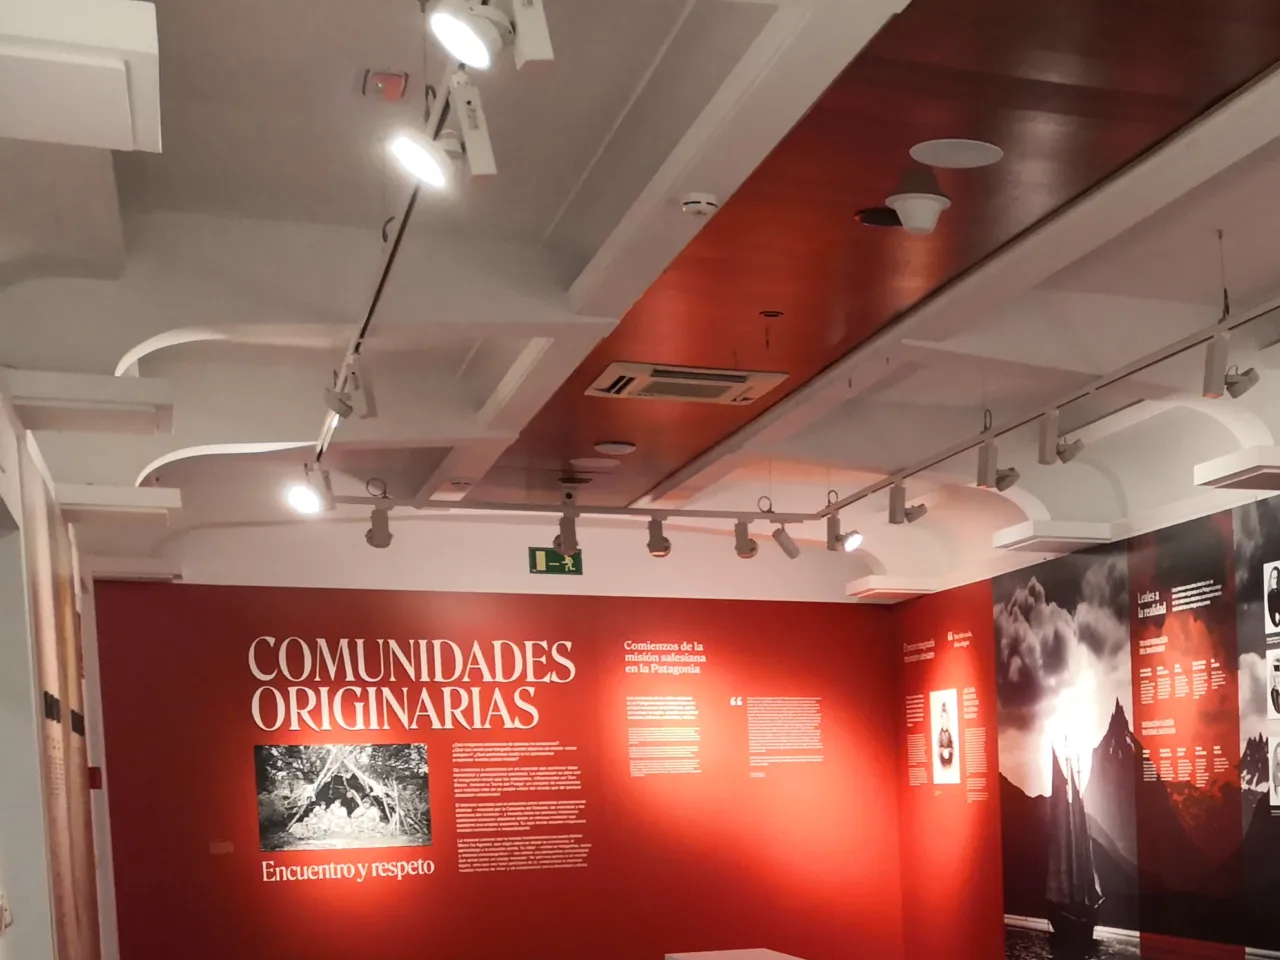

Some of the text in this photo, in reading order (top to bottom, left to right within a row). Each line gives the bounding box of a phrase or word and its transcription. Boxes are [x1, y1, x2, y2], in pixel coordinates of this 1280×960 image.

[624, 641, 704, 651] Comienzos de la
[248, 636, 576, 683] COMUNIDADES
[625, 651, 707, 663] misión salesiana
[625, 664, 701, 675] en la Patagonia
[250, 685, 539, 732] ORIGINARIAS
[262, 858, 435, 883] Encuentro y respeto
